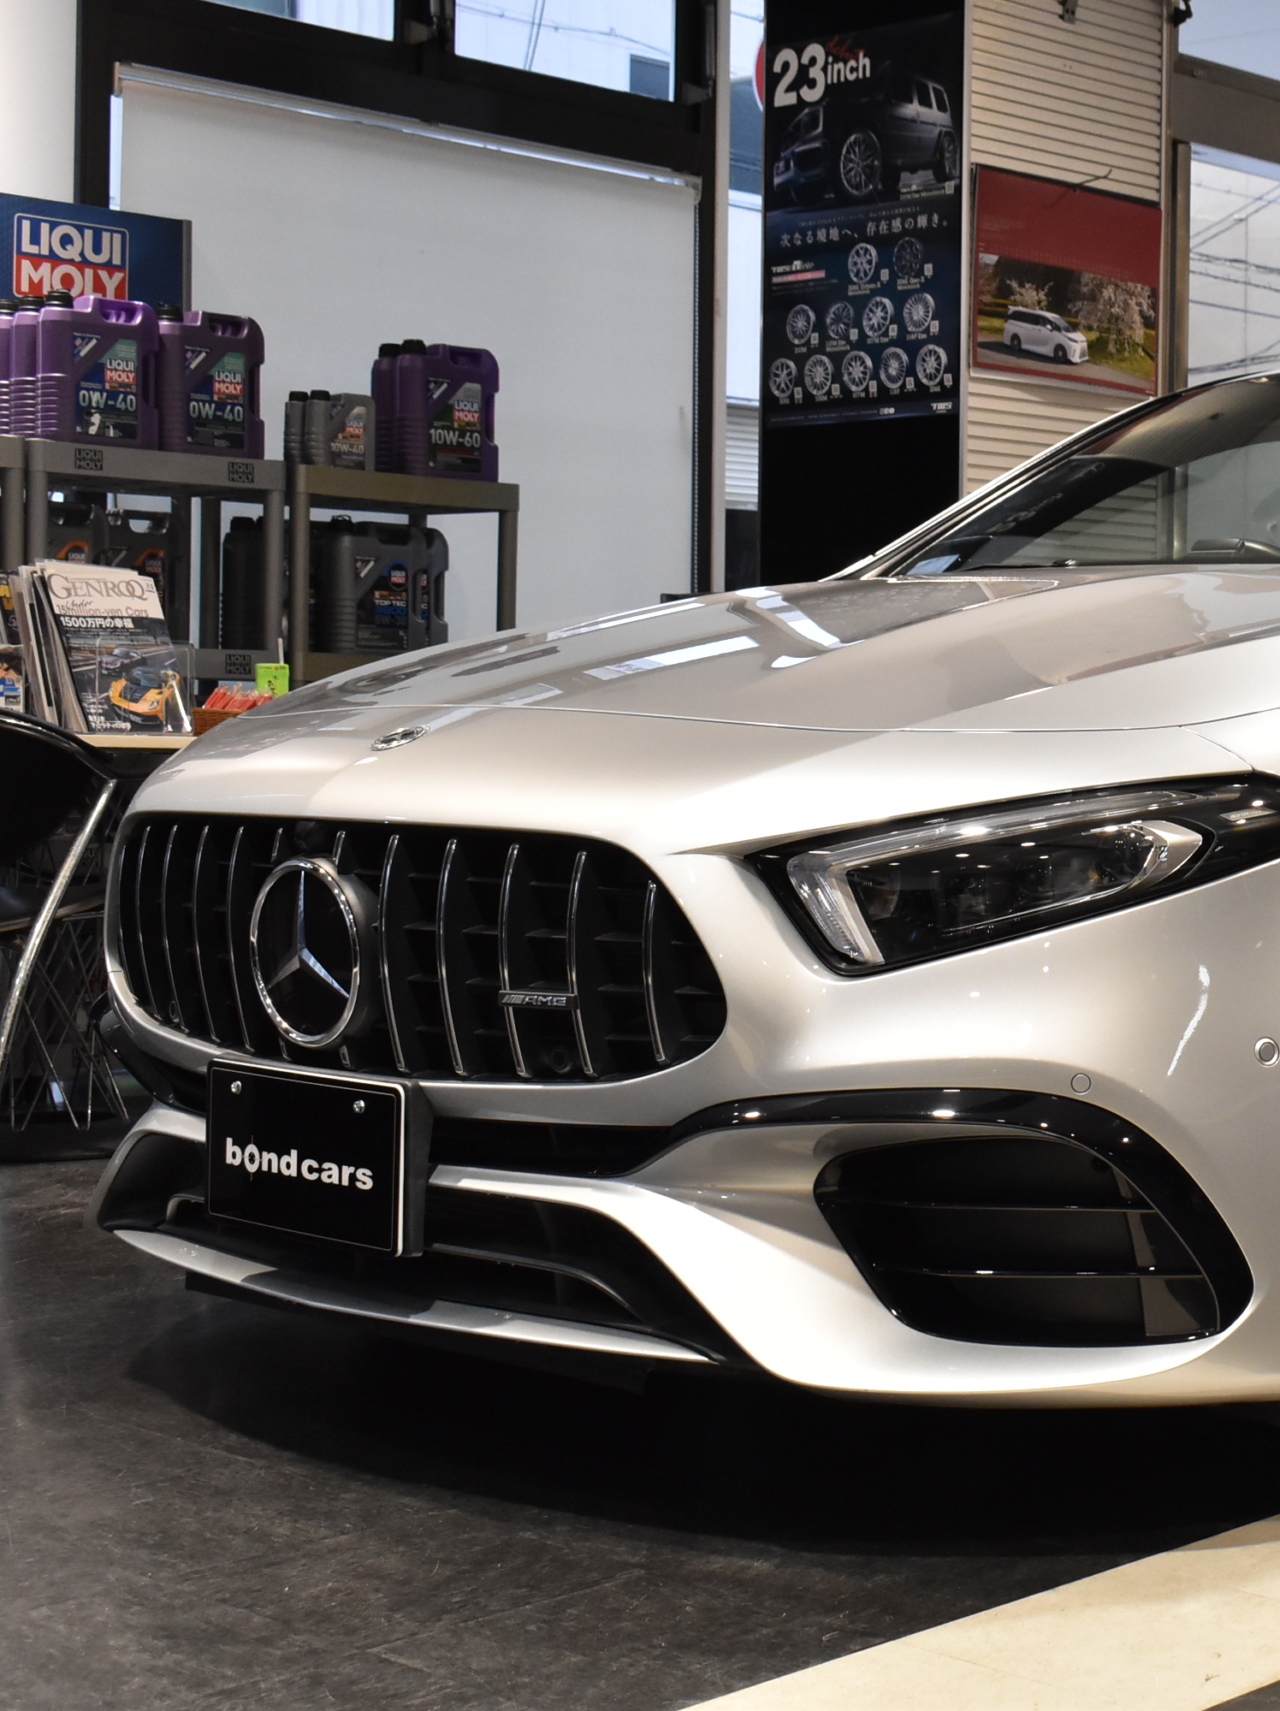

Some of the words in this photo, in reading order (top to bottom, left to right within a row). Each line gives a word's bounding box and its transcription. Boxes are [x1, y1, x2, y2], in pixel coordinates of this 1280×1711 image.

[21, 219, 122, 266] LIQUI
[21, 259, 125, 300] MOLY
[106, 358, 135, 371] LIQUI
[106, 370, 136, 382] MOLY
[215, 371, 242, 383] LIQUI
[215, 382, 243, 394] MOLY
[79, 389, 137, 412] 0W-40
[454, 401, 479, 411] LIQUI
[189, 400, 244, 422] 0W-40
[454, 410, 480, 422] MOLY
[429, 428, 481, 448] 10W-60
[331, 442, 365, 454] 10W-40
[76, 449, 103, 460] LIQUI
[76, 459, 103, 470] MOLY
[229, 463, 254, 473] LIQUI
[229, 472, 254, 483] MOLY
[47, 573, 148, 601] GENROQ
[125, 606, 149, 617] Cars
[227, 654, 250, 664] LIQUI
[226, 664, 250, 674] MOLY
[522, 995, 567, 1007] AMG
[225, 1136, 374, 1191] bondcars
